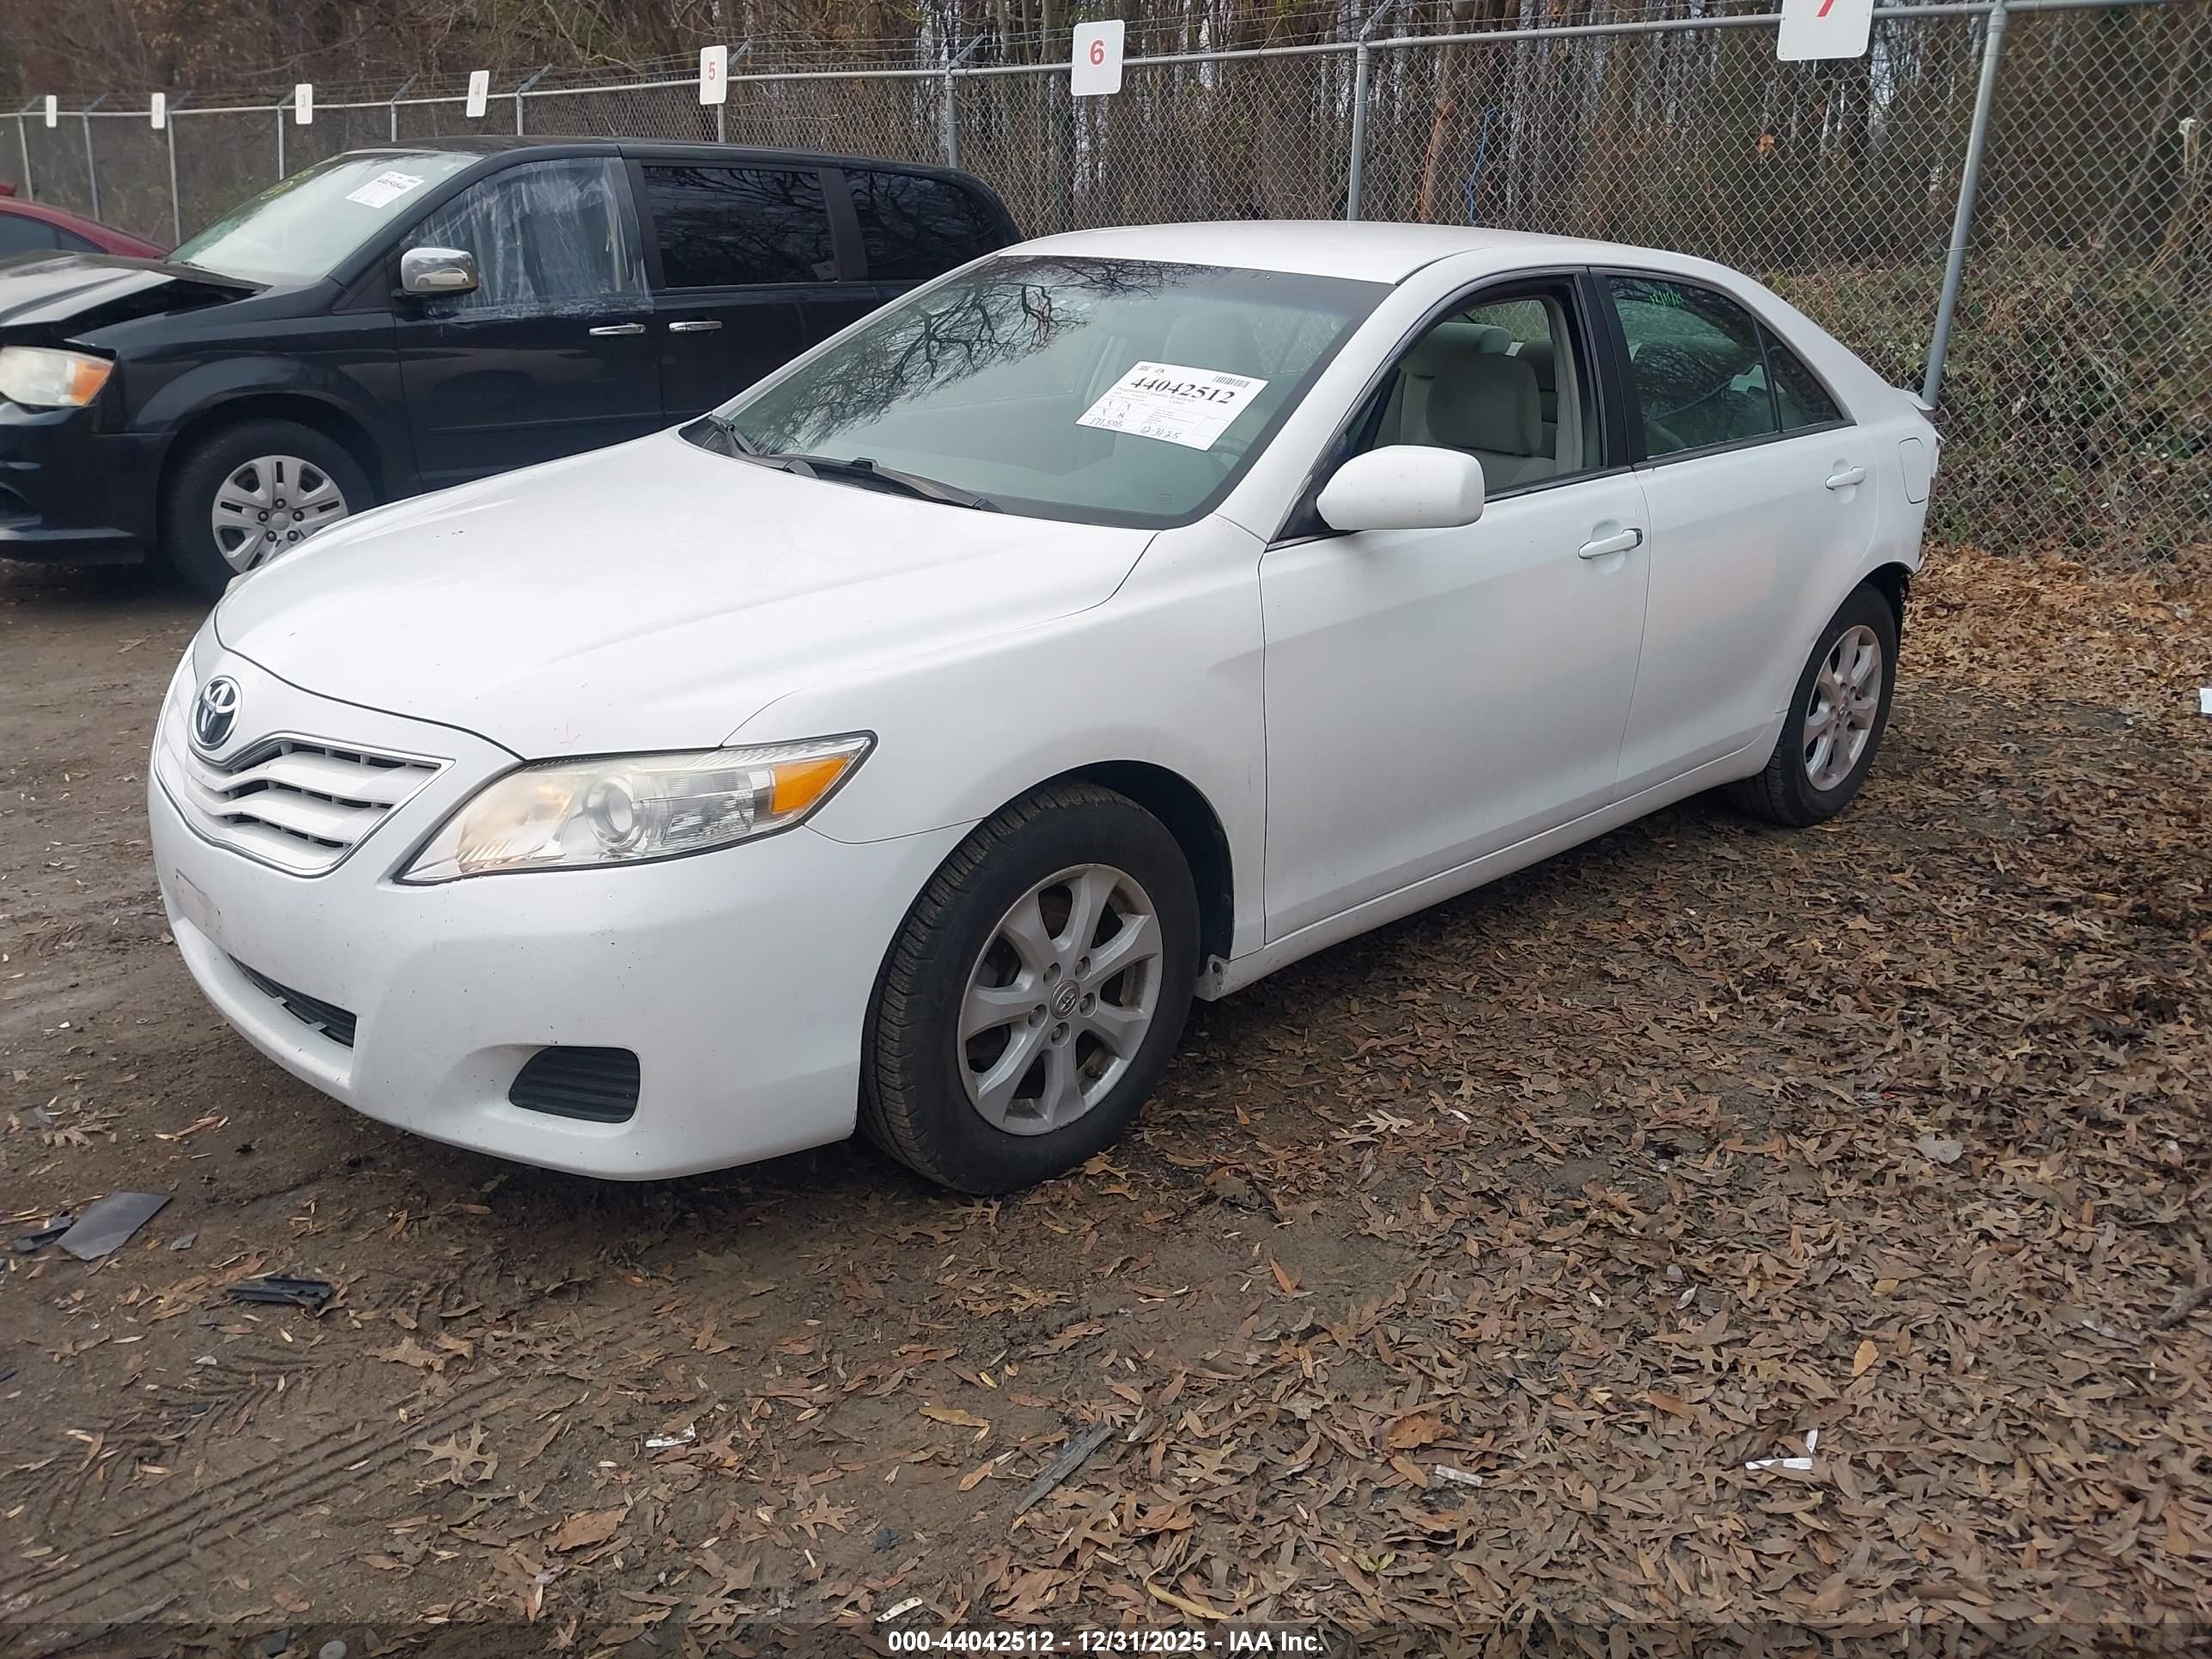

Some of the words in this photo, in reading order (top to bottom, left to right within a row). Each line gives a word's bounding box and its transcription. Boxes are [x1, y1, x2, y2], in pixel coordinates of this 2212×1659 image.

[1090, 40, 1105, 66] 6
[708, 62, 716, 81] 5
[1130, 376, 1236, 404] 44042512
